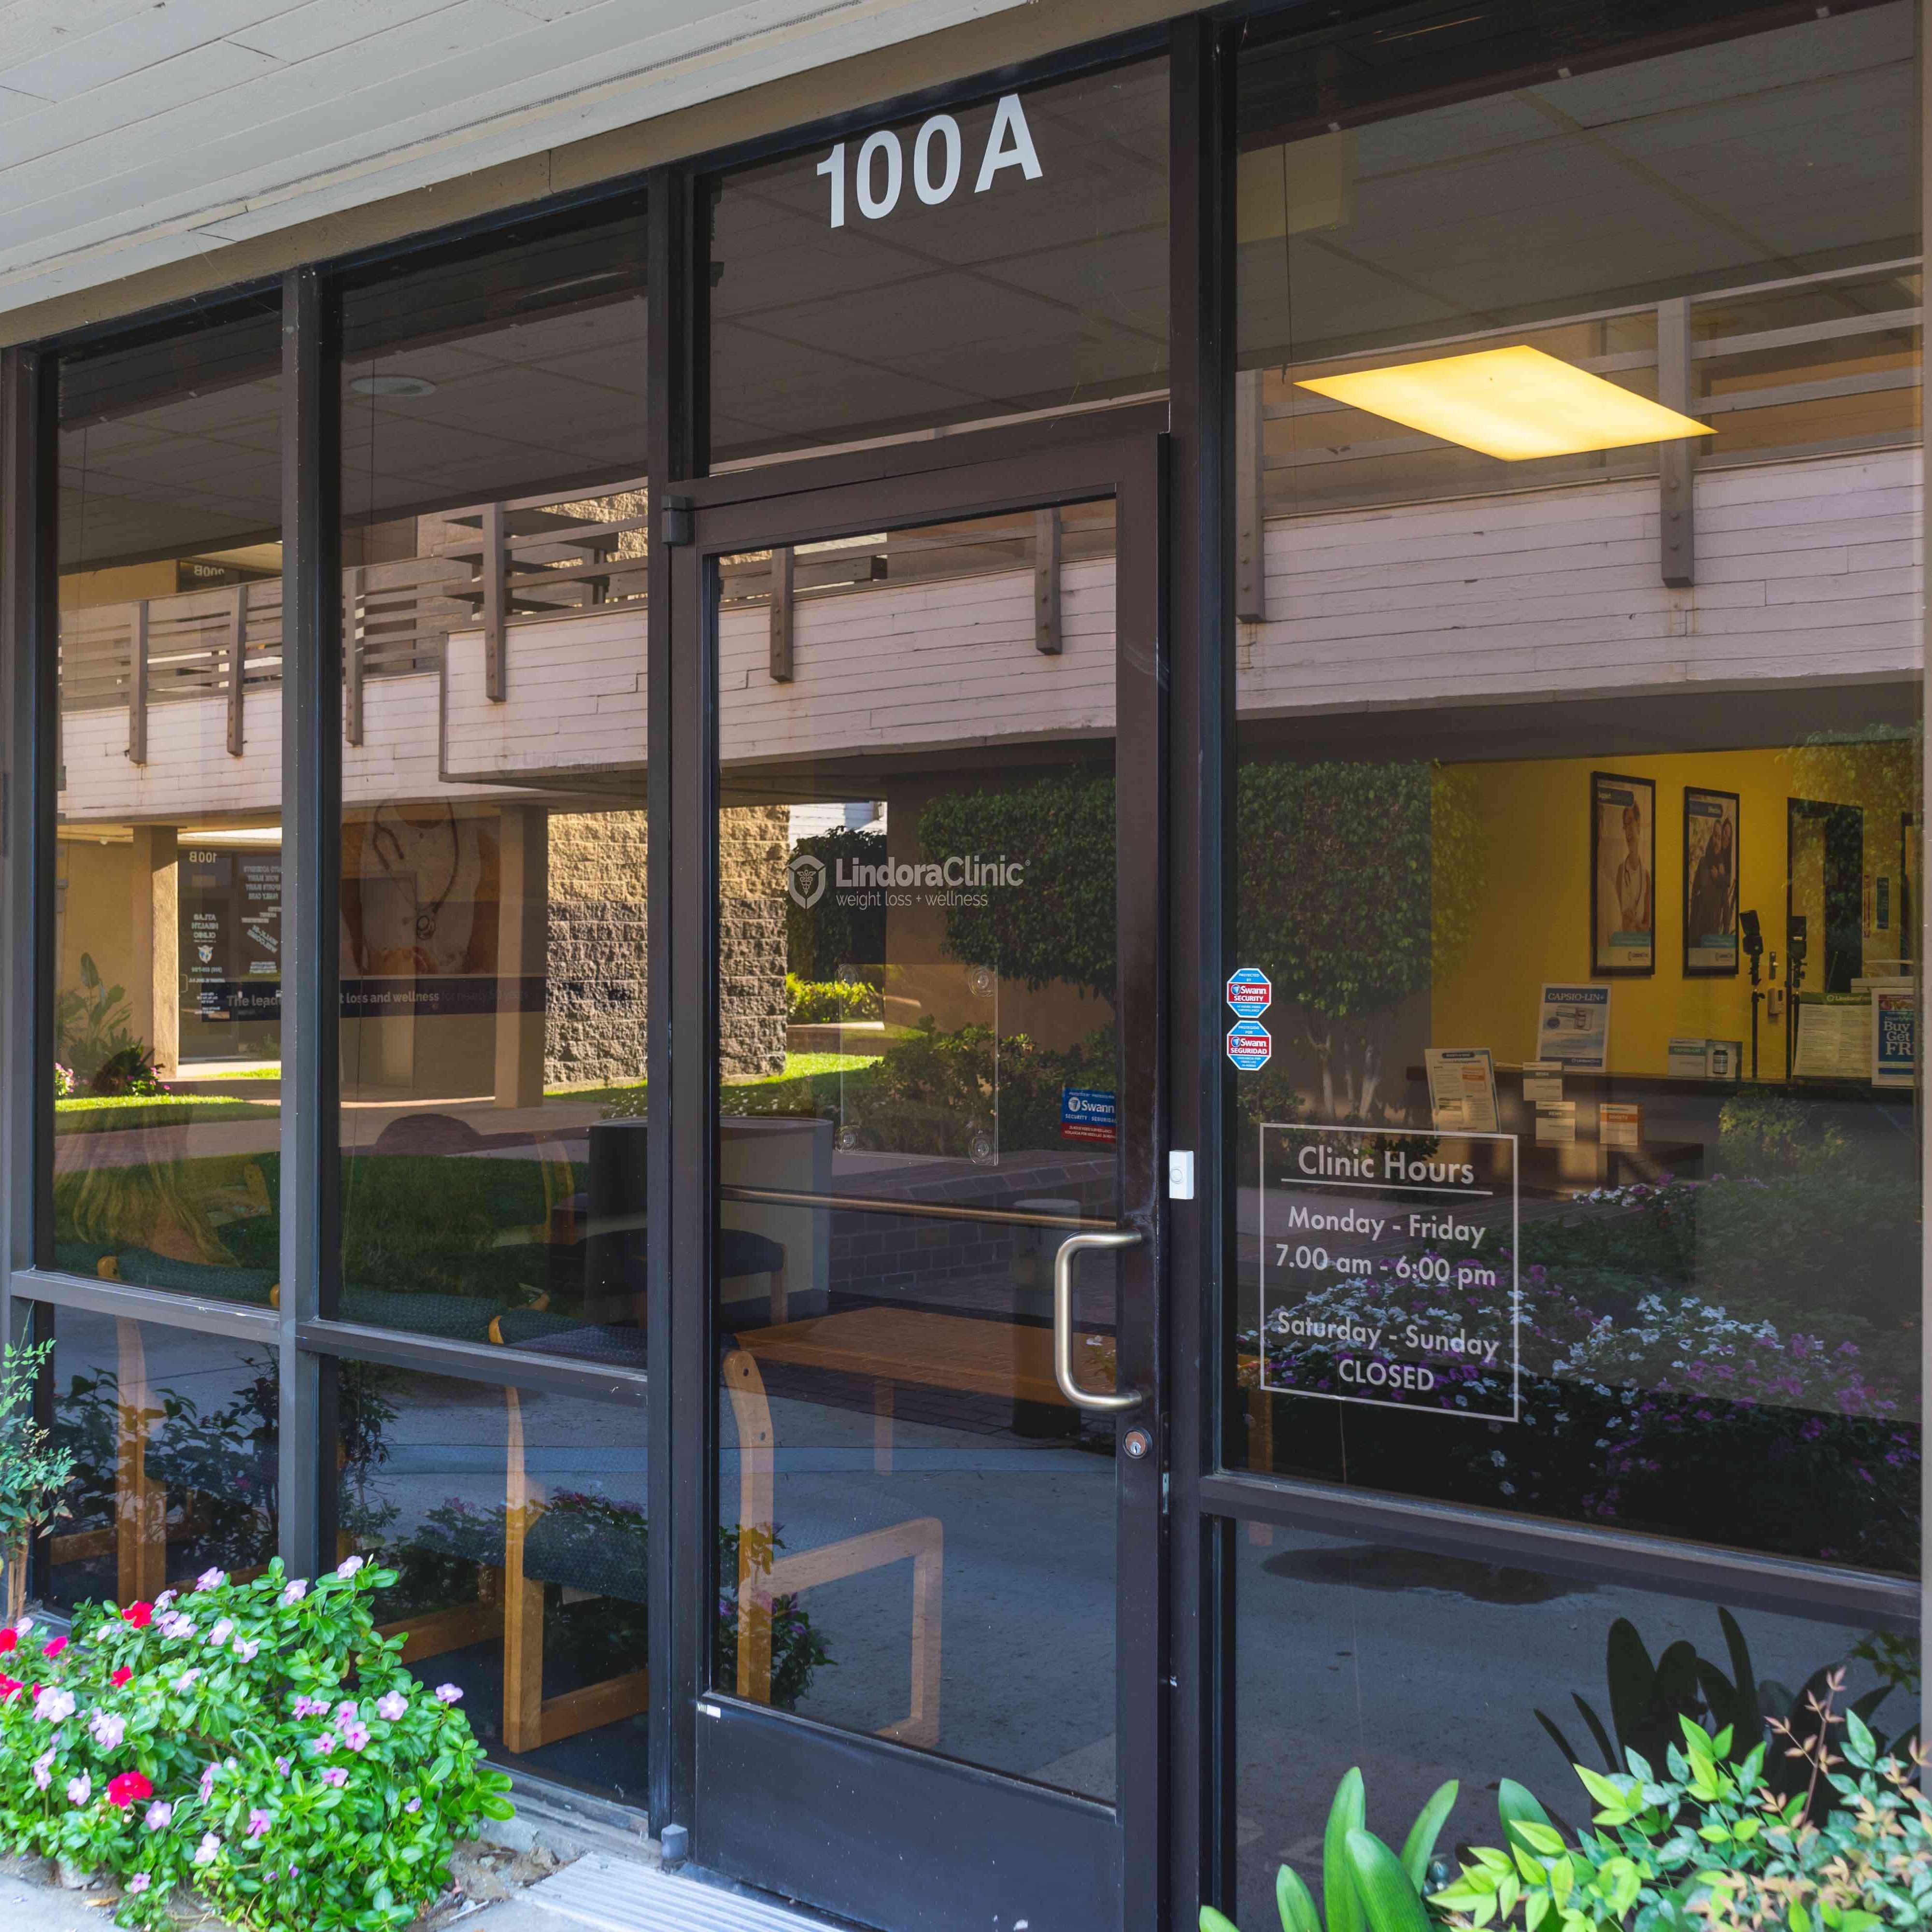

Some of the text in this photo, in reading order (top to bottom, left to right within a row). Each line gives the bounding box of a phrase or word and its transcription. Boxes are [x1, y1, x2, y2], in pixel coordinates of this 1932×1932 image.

[836, 891, 881, 910] weight
[886, 891, 911, 906] loss
[924, 891, 988, 906] wellness
[346, 992, 368, 1003] loss
[370, 992, 391, 1003] and
[393, 990, 439, 1003] wellness
[1241, 986, 1266, 994] Swann
[227, 994, 249, 1006] The
[1884, 1021, 1910, 1034] Buy
[1240, 1038, 1266, 1047] Swann
[1887, 1031, 1910, 1041] Get
[1886, 1041, 1914, 1055] FR
[1081, 1100, 1114, 1113] Swann
[1298, 1144, 1474, 1184] Clinic Hours
[1289, 1206, 1385, 1240] Monday
[1409, 1214, 1486, 1249] Friday
[1276, 1244, 1328, 1270] 7.00
[1336, 1256, 1372, 1275] am
[1395, 1256, 1450, 1281] 6:00
[1458, 1266, 1495, 1291] pm
[1278, 1311, 1381, 1350] Saturday
[1405, 1325, 1499, 1364] Sunday
[1339, 1359, 1434, 1391] CLOSED
